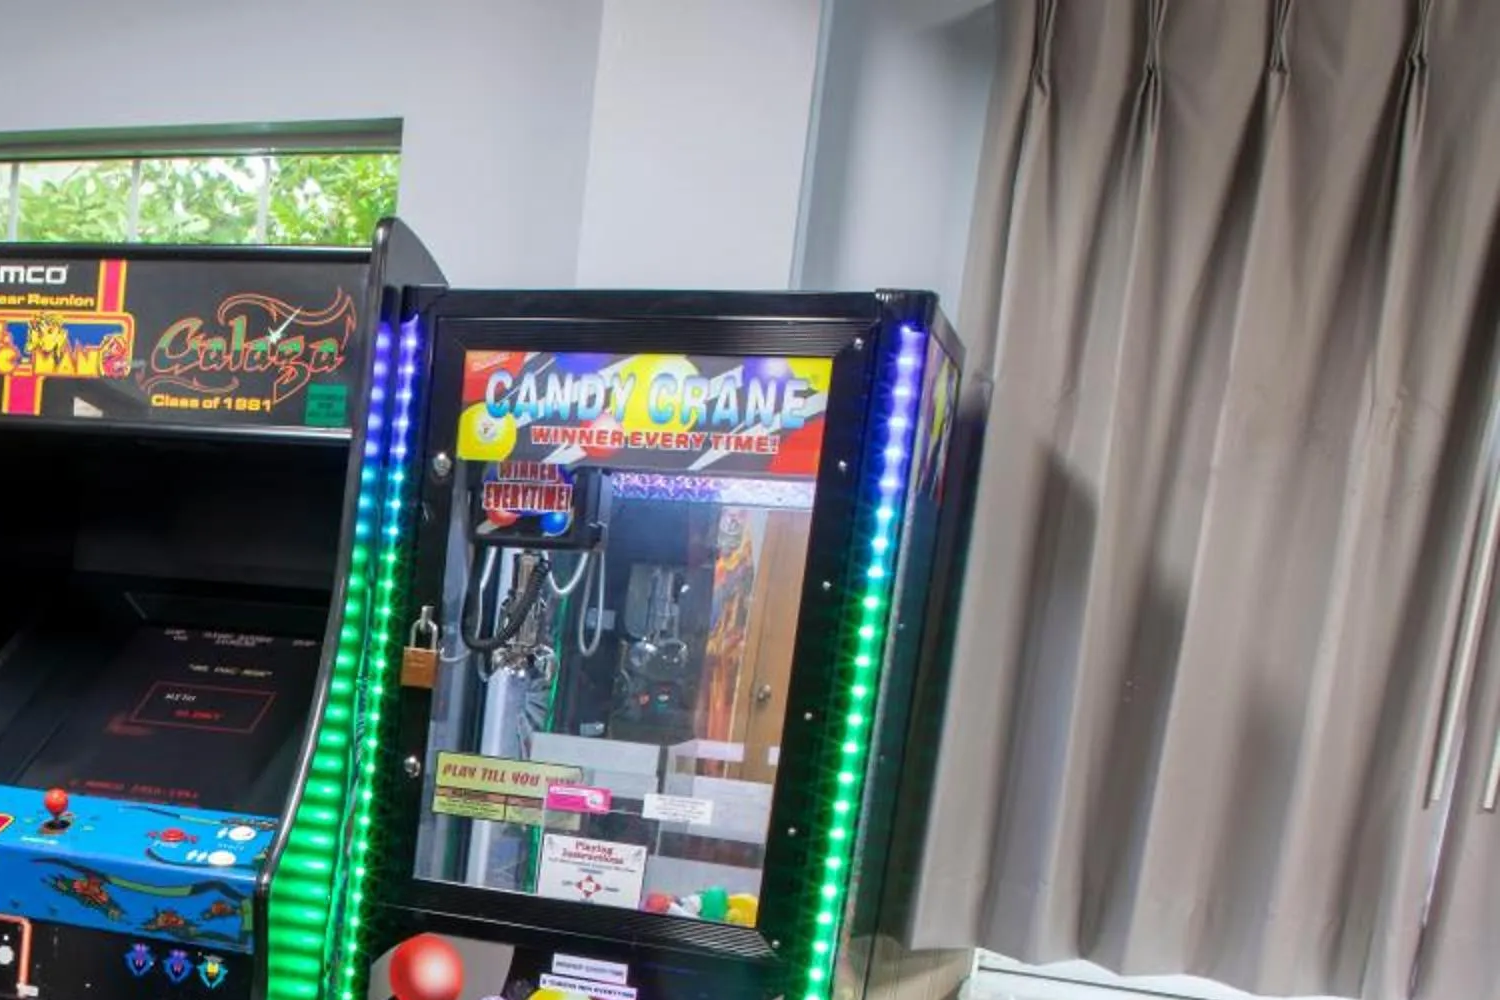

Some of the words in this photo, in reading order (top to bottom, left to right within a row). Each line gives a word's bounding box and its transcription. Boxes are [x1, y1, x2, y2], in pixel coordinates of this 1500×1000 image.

[27, 294, 95, 307] Reunion
[151, 394, 199, 409] Class
[202, 396, 219, 410] of
[484, 369, 637, 423] CANDY
[647, 372, 810, 429] CRANE
[530, 425, 628, 448] WINNER
[629, 429, 708, 451] EVERY
[709, 432, 780, 455] TIME!
[443, 763, 477, 779] PLAY
[480, 767, 506, 783] TILL
[511, 771, 541, 787] YOU
